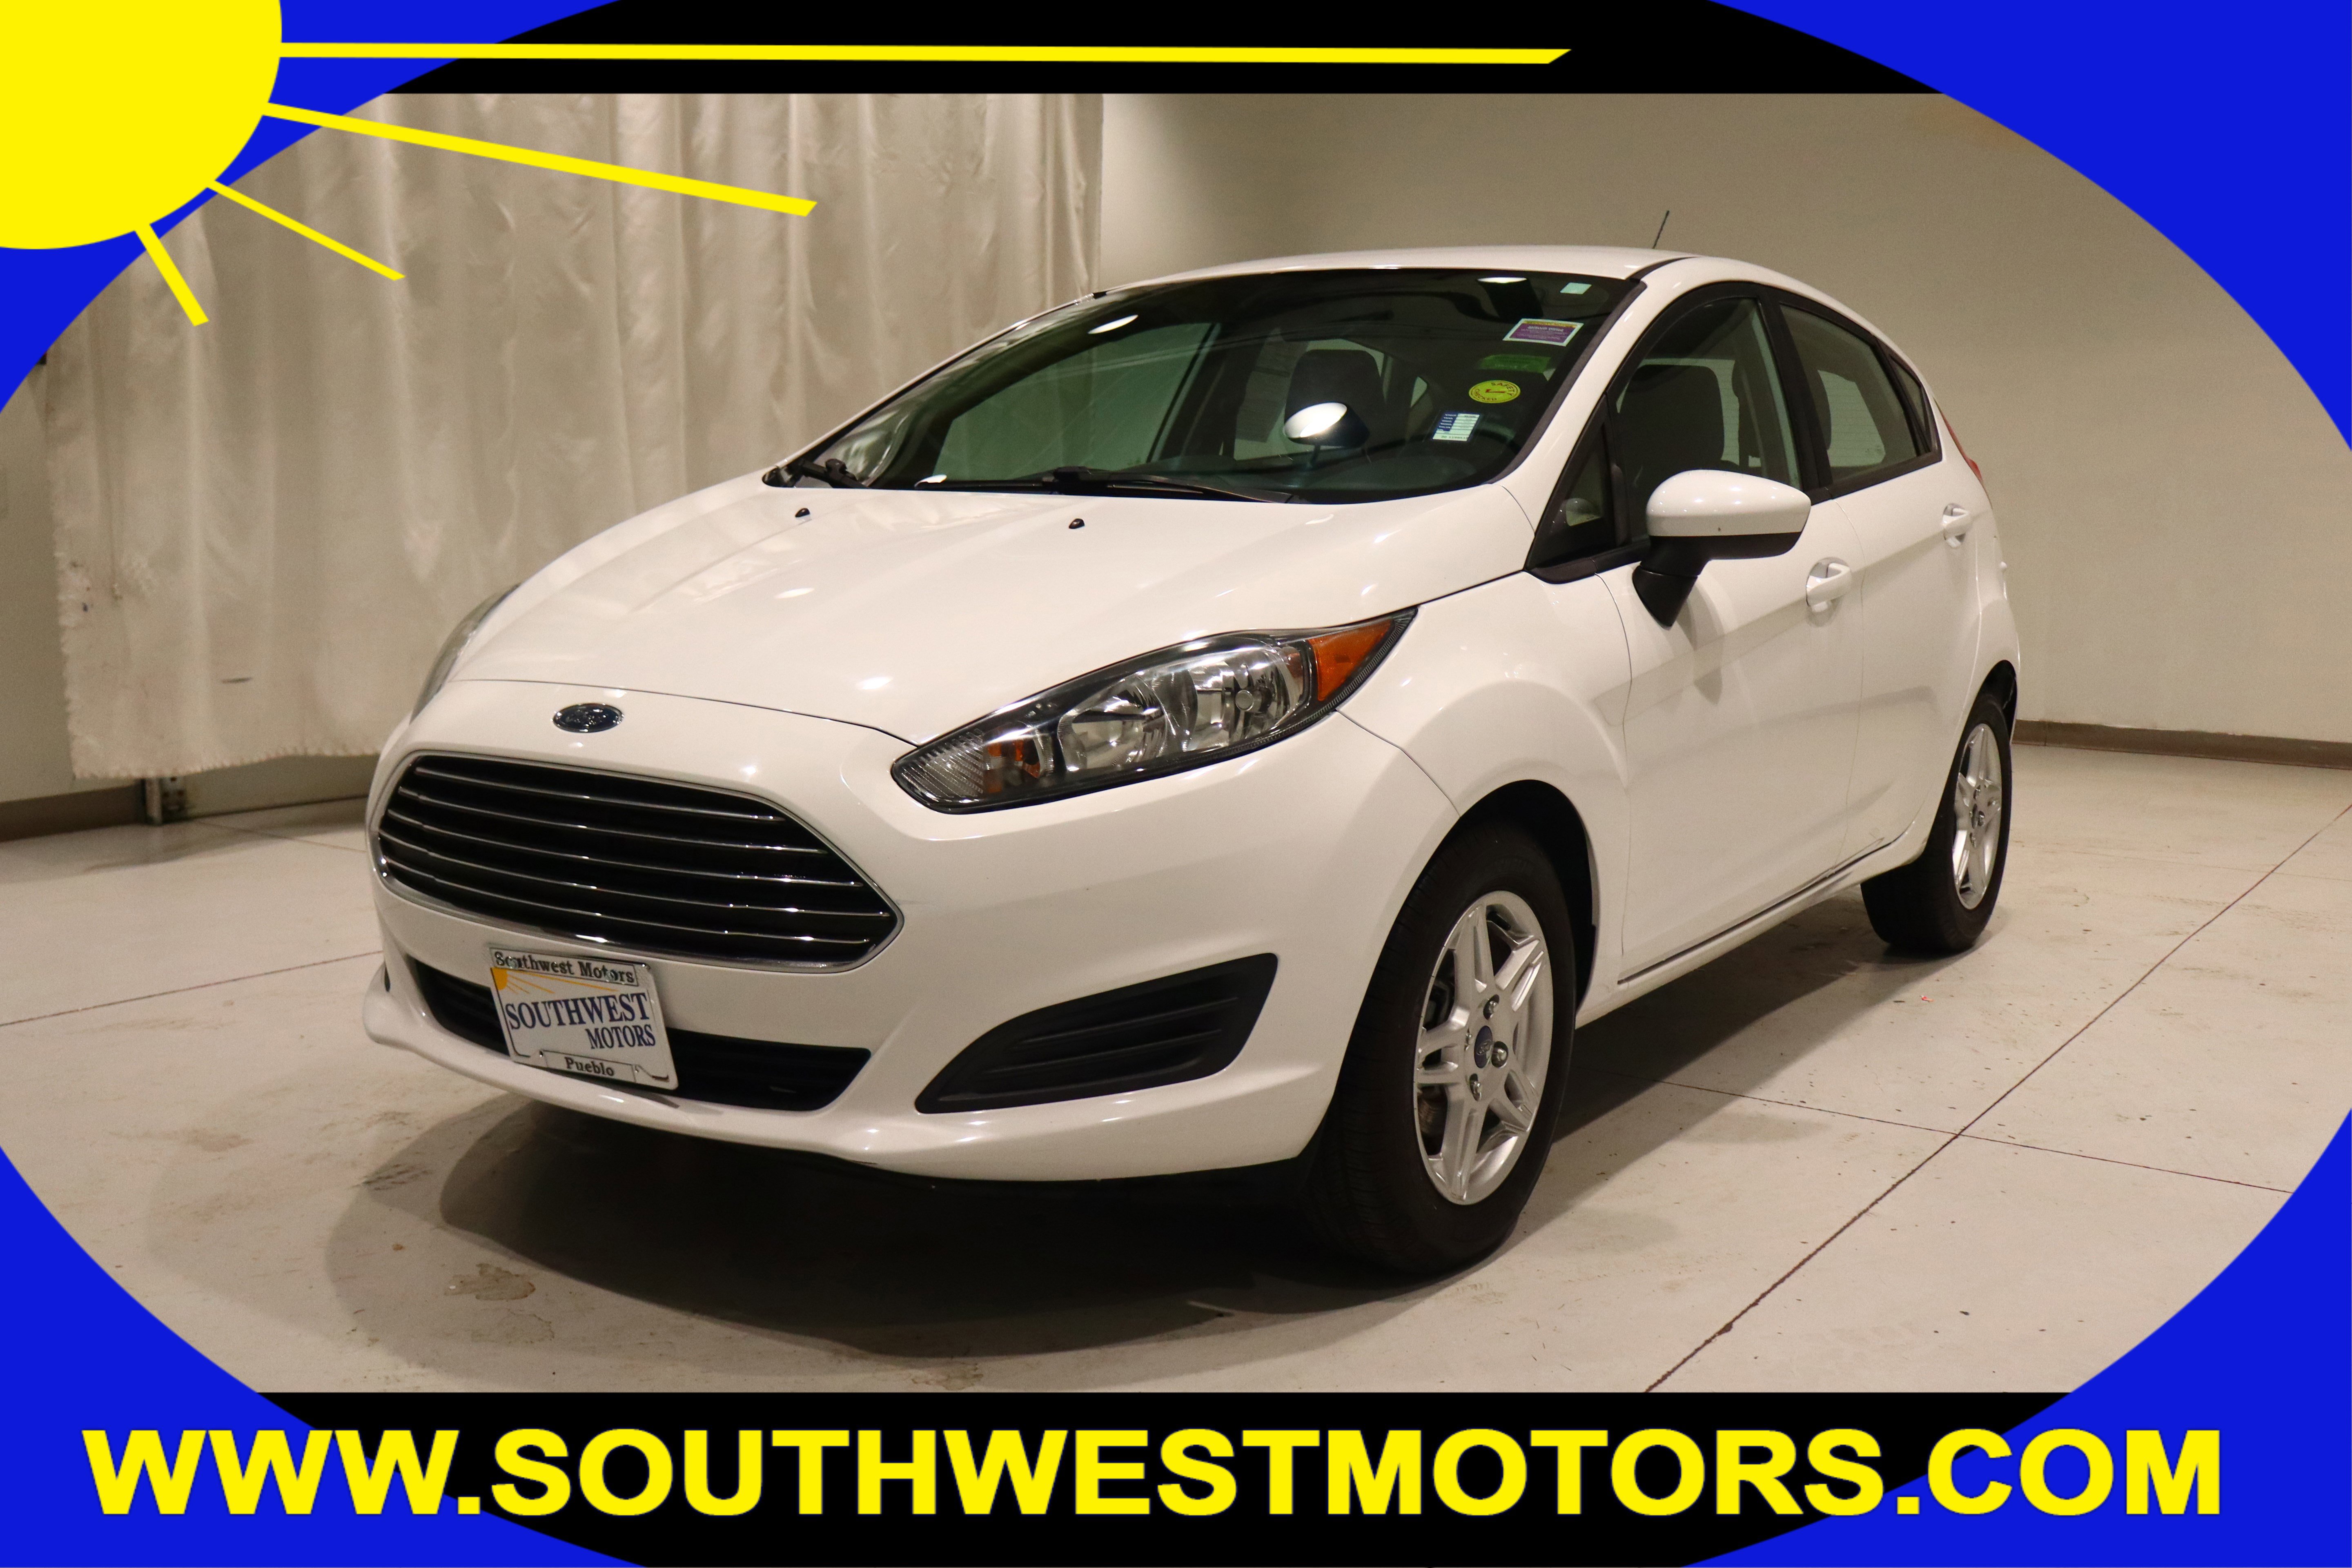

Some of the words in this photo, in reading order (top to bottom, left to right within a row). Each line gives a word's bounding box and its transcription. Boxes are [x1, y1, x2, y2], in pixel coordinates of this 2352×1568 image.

[1474, 389, 1497, 401] CHECKED
[1491, 382, 1515, 396] SAFETY
[578, 961, 635, 983] Motors
[505, 993, 650, 1030] SOUTHWEST
[585, 1024, 656, 1049] MOTORS
[564, 1057, 615, 1077] Pueblo
